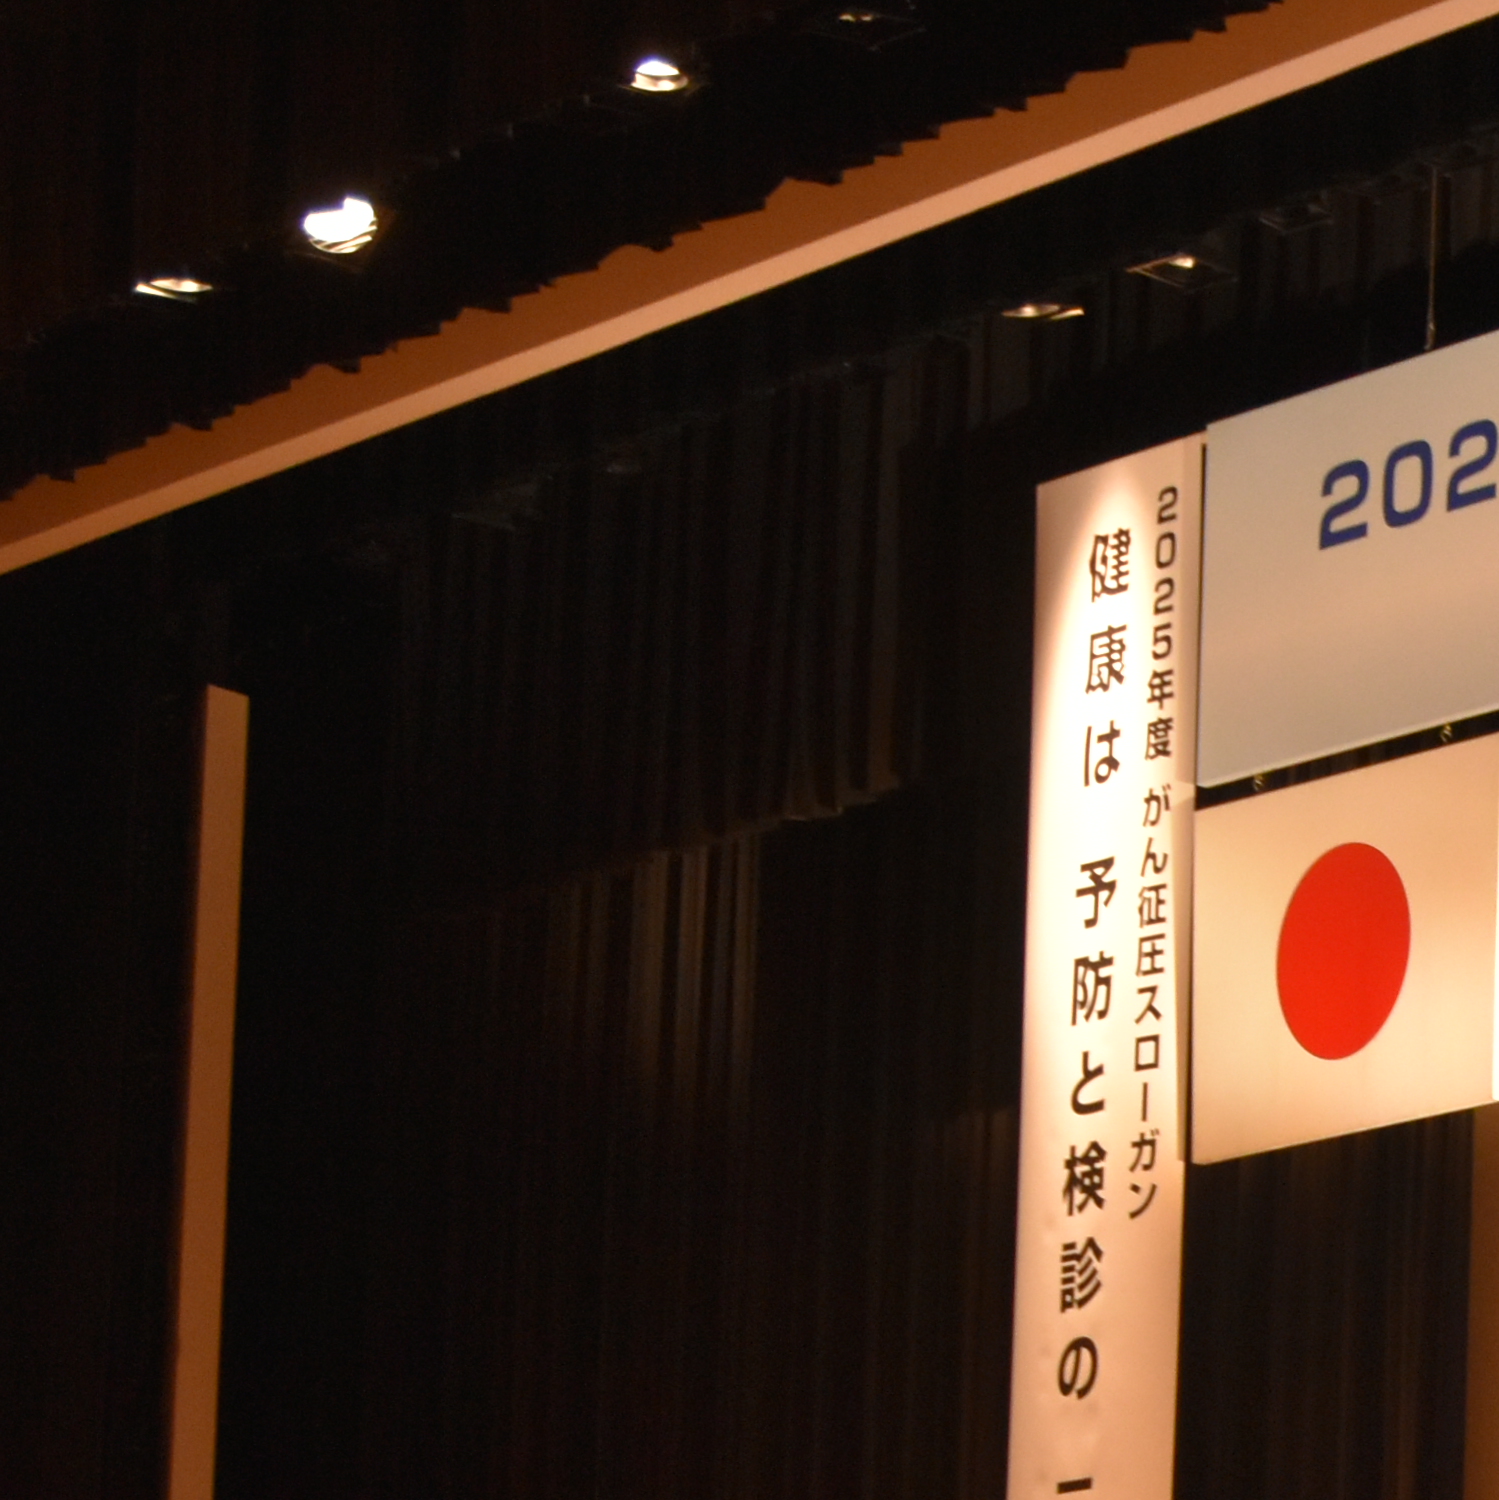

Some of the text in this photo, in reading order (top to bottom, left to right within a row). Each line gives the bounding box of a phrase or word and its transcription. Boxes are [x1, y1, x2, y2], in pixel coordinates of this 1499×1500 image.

[1084, 527, 1132, 787] 健康は
[1127, 486, 1179, 1220] 2025年度 がん征圧スローガン
[1056, 856, 1119, 1400] 予防と検診の
